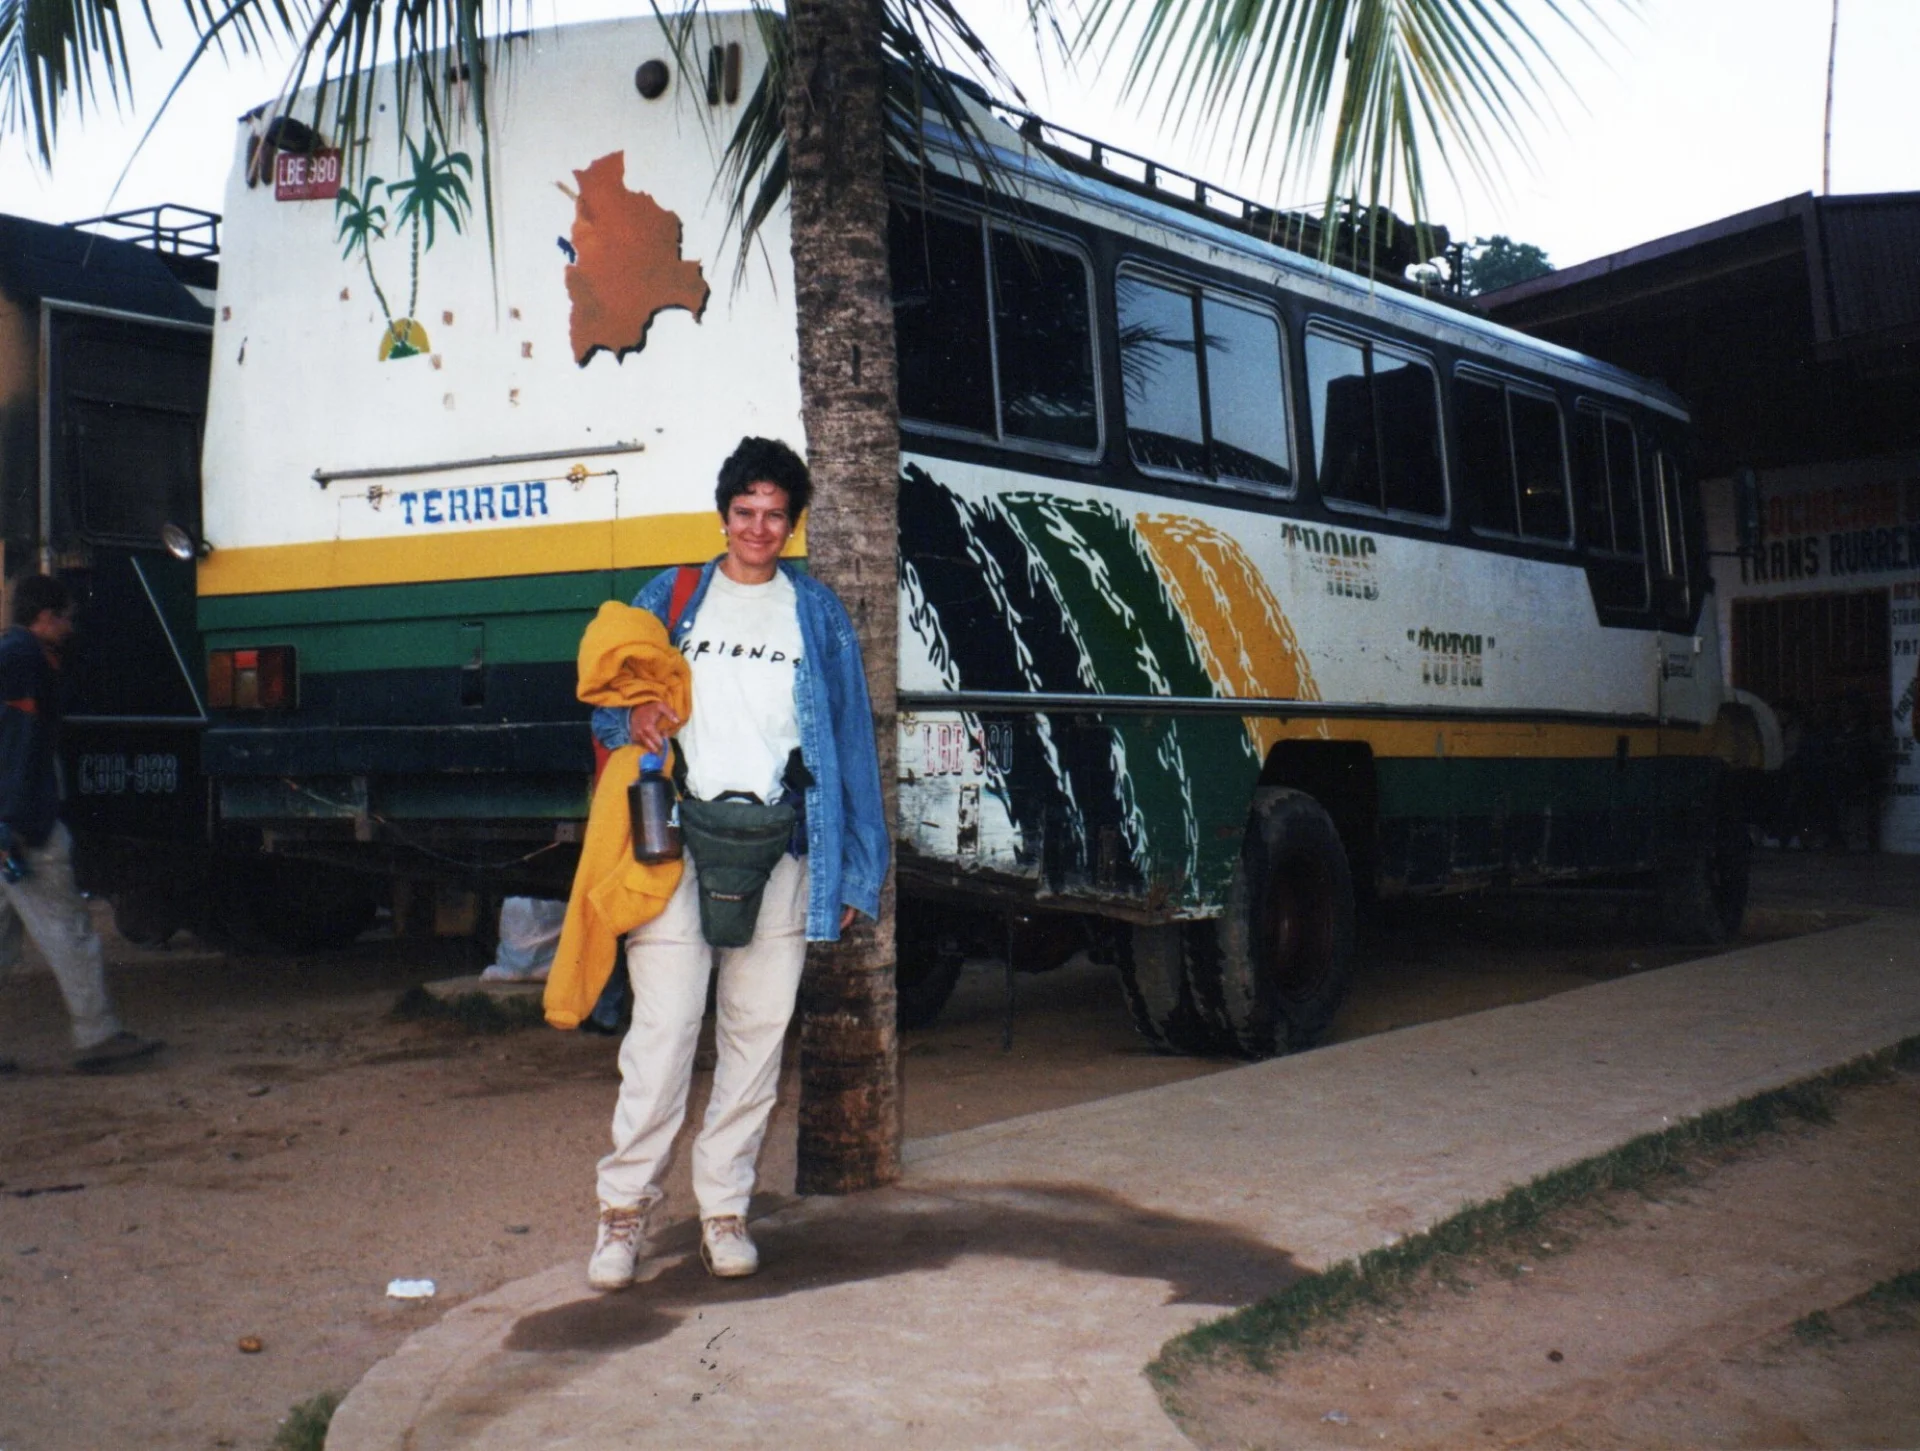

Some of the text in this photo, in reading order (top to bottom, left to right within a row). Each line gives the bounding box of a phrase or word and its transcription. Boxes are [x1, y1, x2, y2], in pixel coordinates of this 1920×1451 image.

[279, 158, 305, 186] LBE
[400, 482, 548, 525] TERROR
[1738, 535, 1819, 586] TRANS
[680, 640, 801, 669] FRIENDS
[923, 724, 964, 776] LBE
